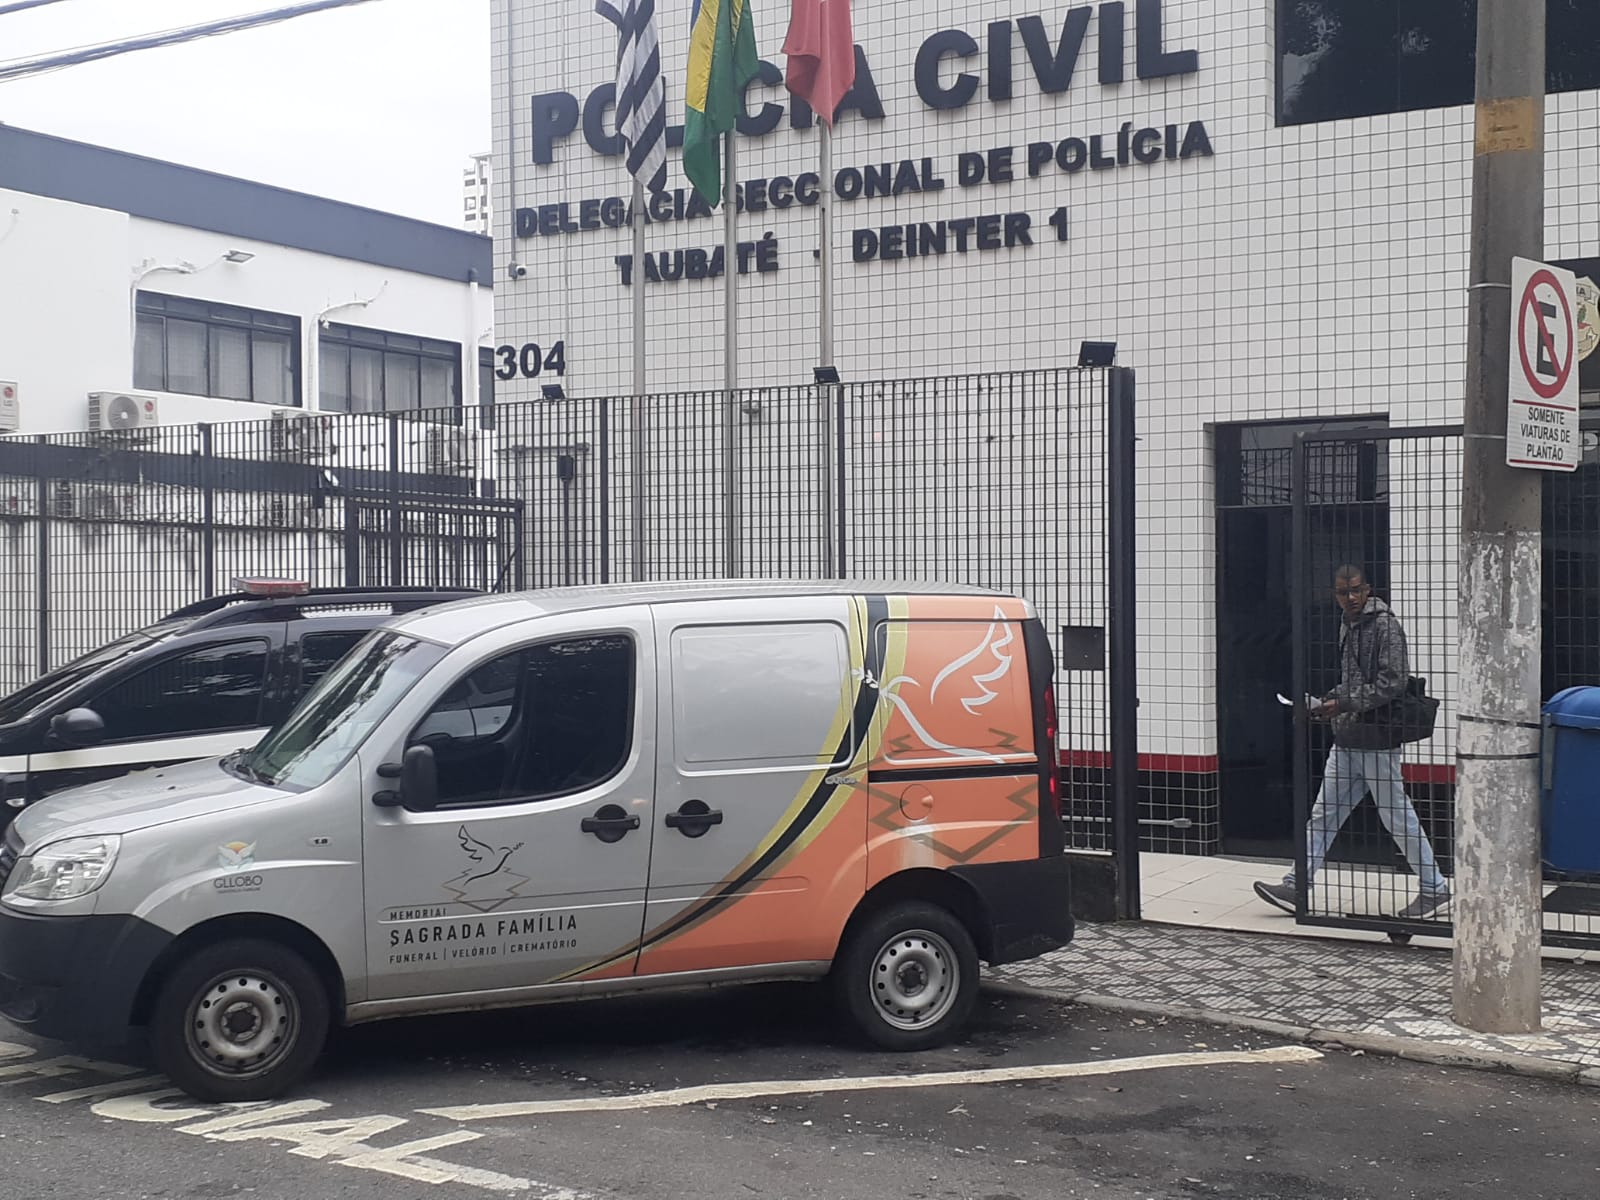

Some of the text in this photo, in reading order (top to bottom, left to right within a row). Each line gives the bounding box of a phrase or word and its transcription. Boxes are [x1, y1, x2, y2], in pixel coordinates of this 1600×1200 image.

[531, 0, 1199, 164] POCA CIVIL
[516, 121, 1214, 238] DELEGACIA SECCONAL DE POLÍCIA
[615, 207, 1068, 285] TAUBATÉ DEINTER 1
[495, 340, 566, 380] 304
[1528, 406, 1565, 425] SOMENTE
[1520, 423, 1570, 443] VIATURAS DE
[1526, 443, 1564, 461] PLANTÃO
[390, 913, 577, 947] SAGRADA FAMÍLIA
[389, 939, 577, 964] FUNERAL VELÓRIO CREMATÓRIO
